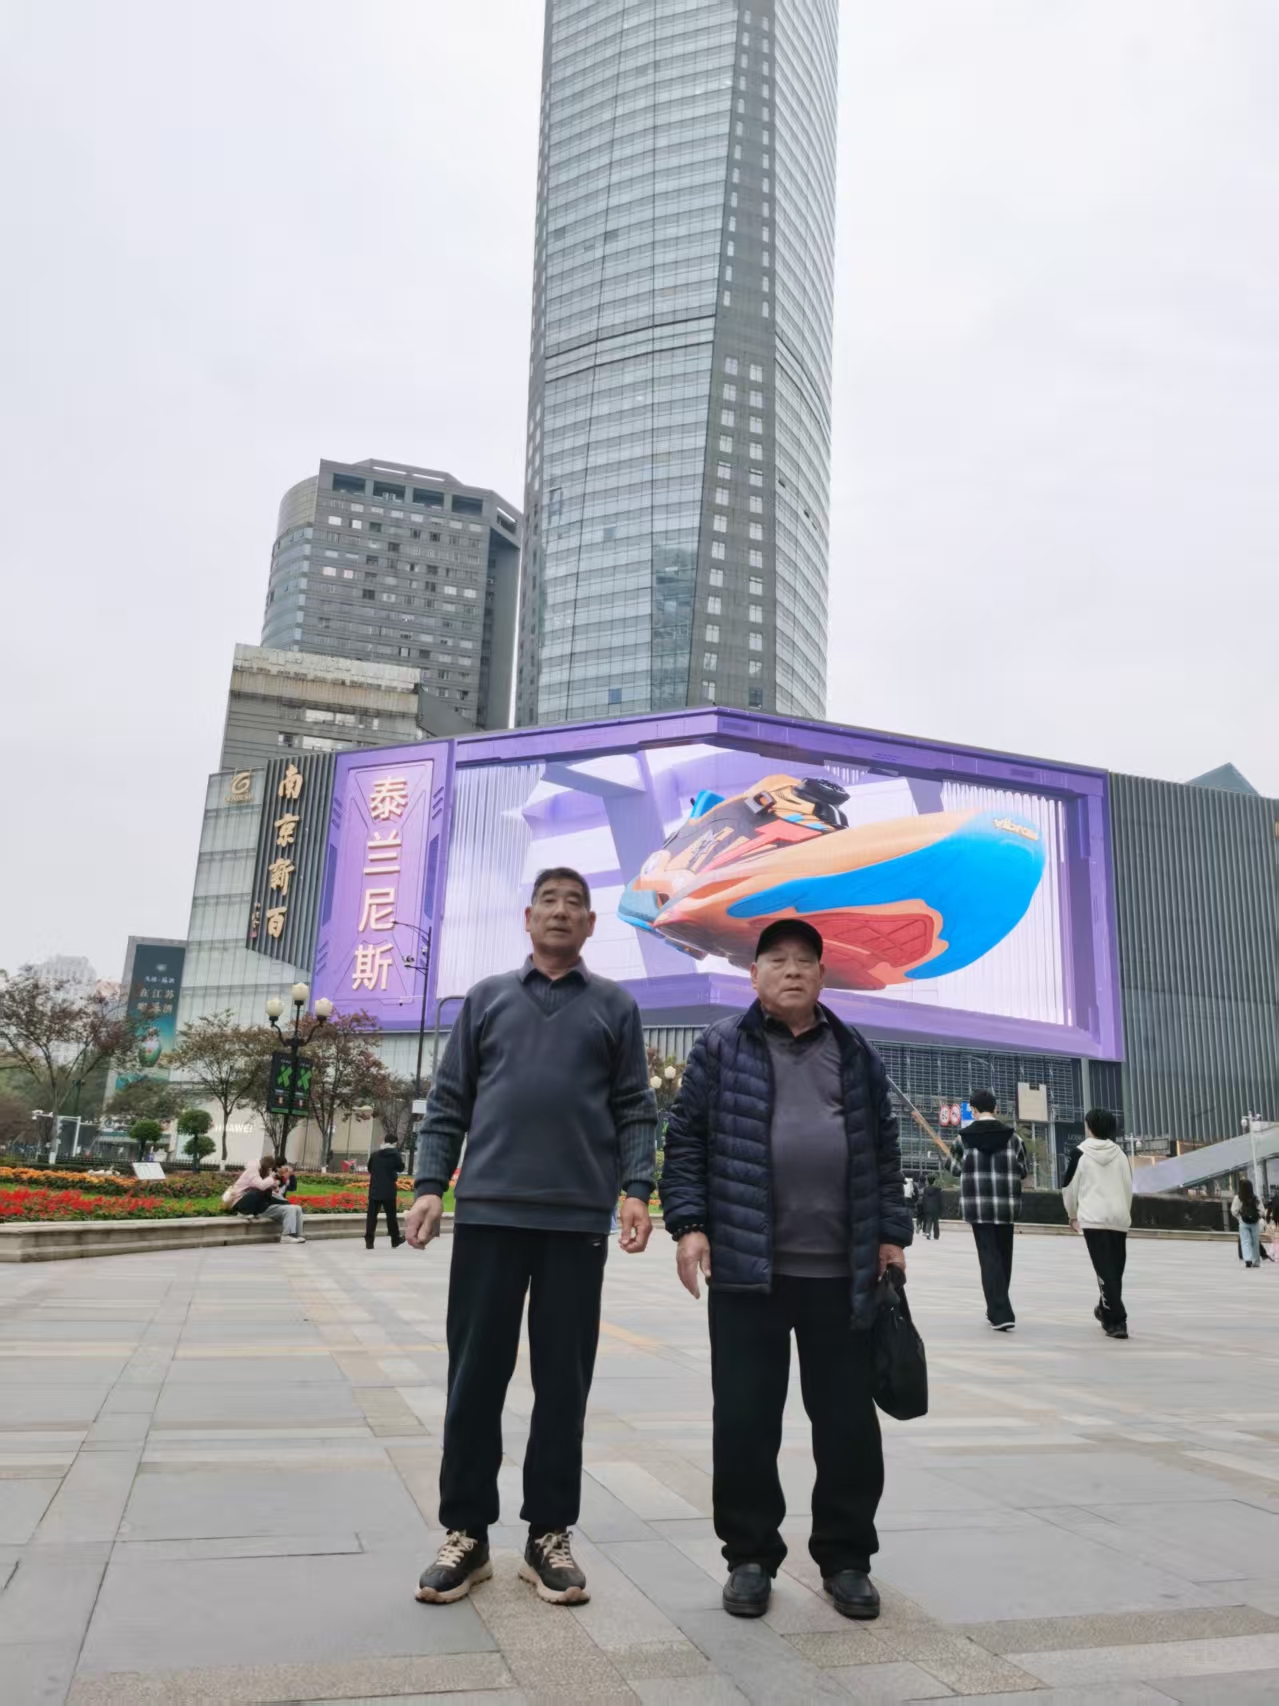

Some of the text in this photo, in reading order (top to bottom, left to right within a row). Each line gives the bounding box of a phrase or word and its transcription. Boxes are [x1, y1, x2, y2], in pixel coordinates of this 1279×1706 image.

[266, 764, 304, 938] 南京新百
[352, 776, 408, 992] 泰兰尼斯
